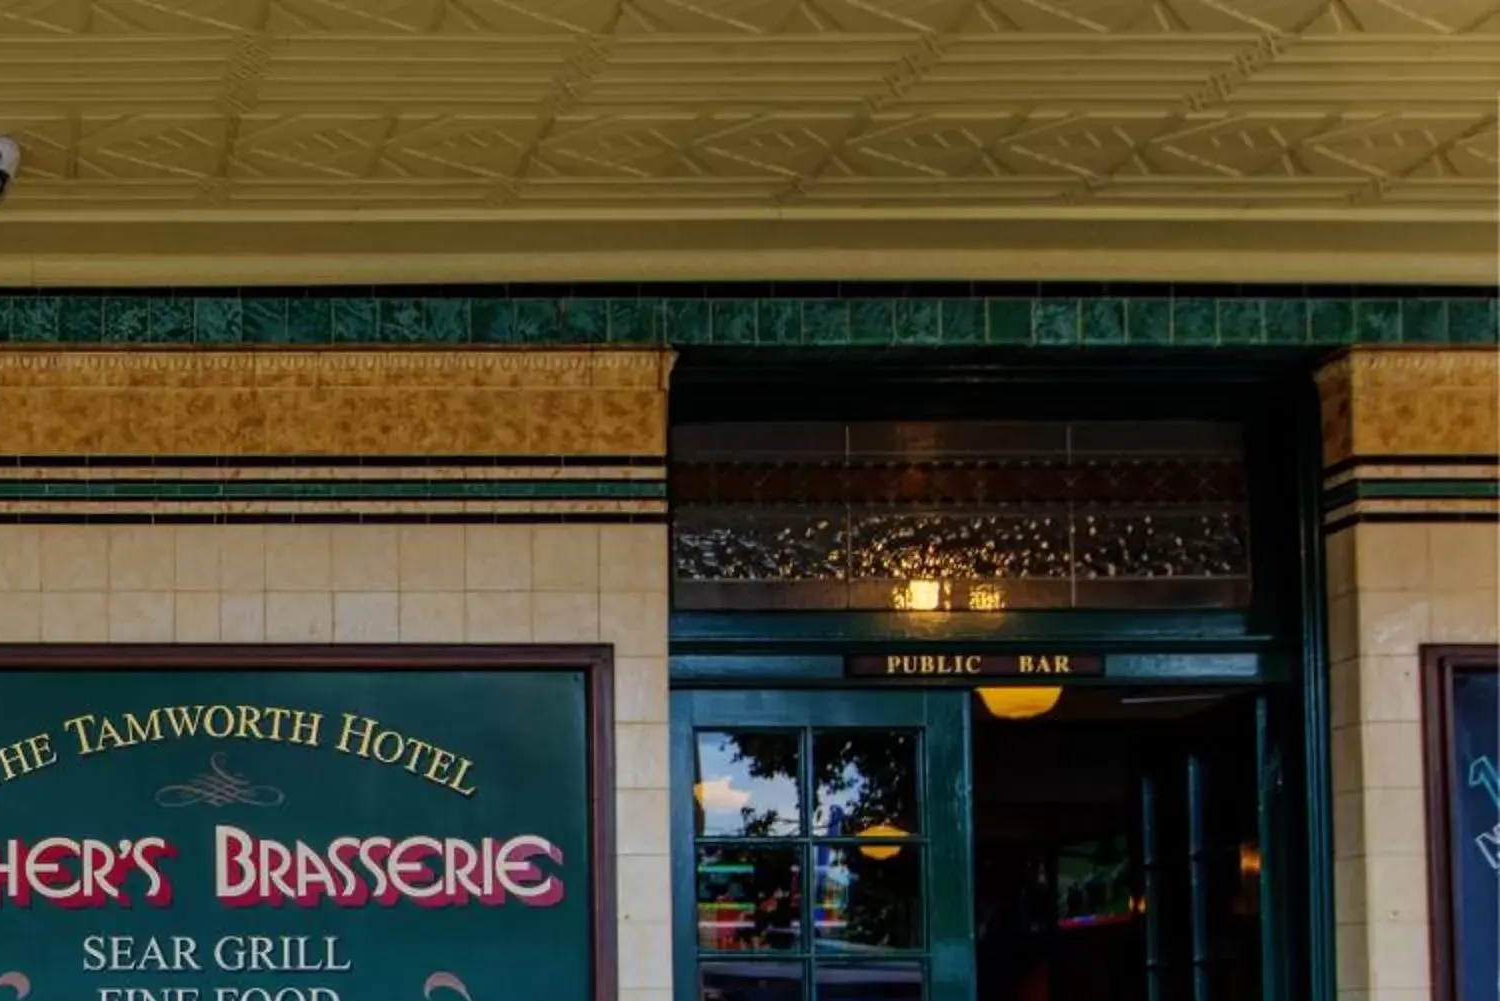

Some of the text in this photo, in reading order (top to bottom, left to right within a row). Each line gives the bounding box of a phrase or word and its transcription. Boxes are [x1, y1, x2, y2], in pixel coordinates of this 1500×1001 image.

[887, 655, 1071, 674] PUBLIC BAR
[64, 705, 324, 755] TAMWORTH
[335, 713, 477, 796] HOTEL
[215, 824, 559, 904] BRASSERIE
[82, 934, 352, 971] SEAR GRILL
